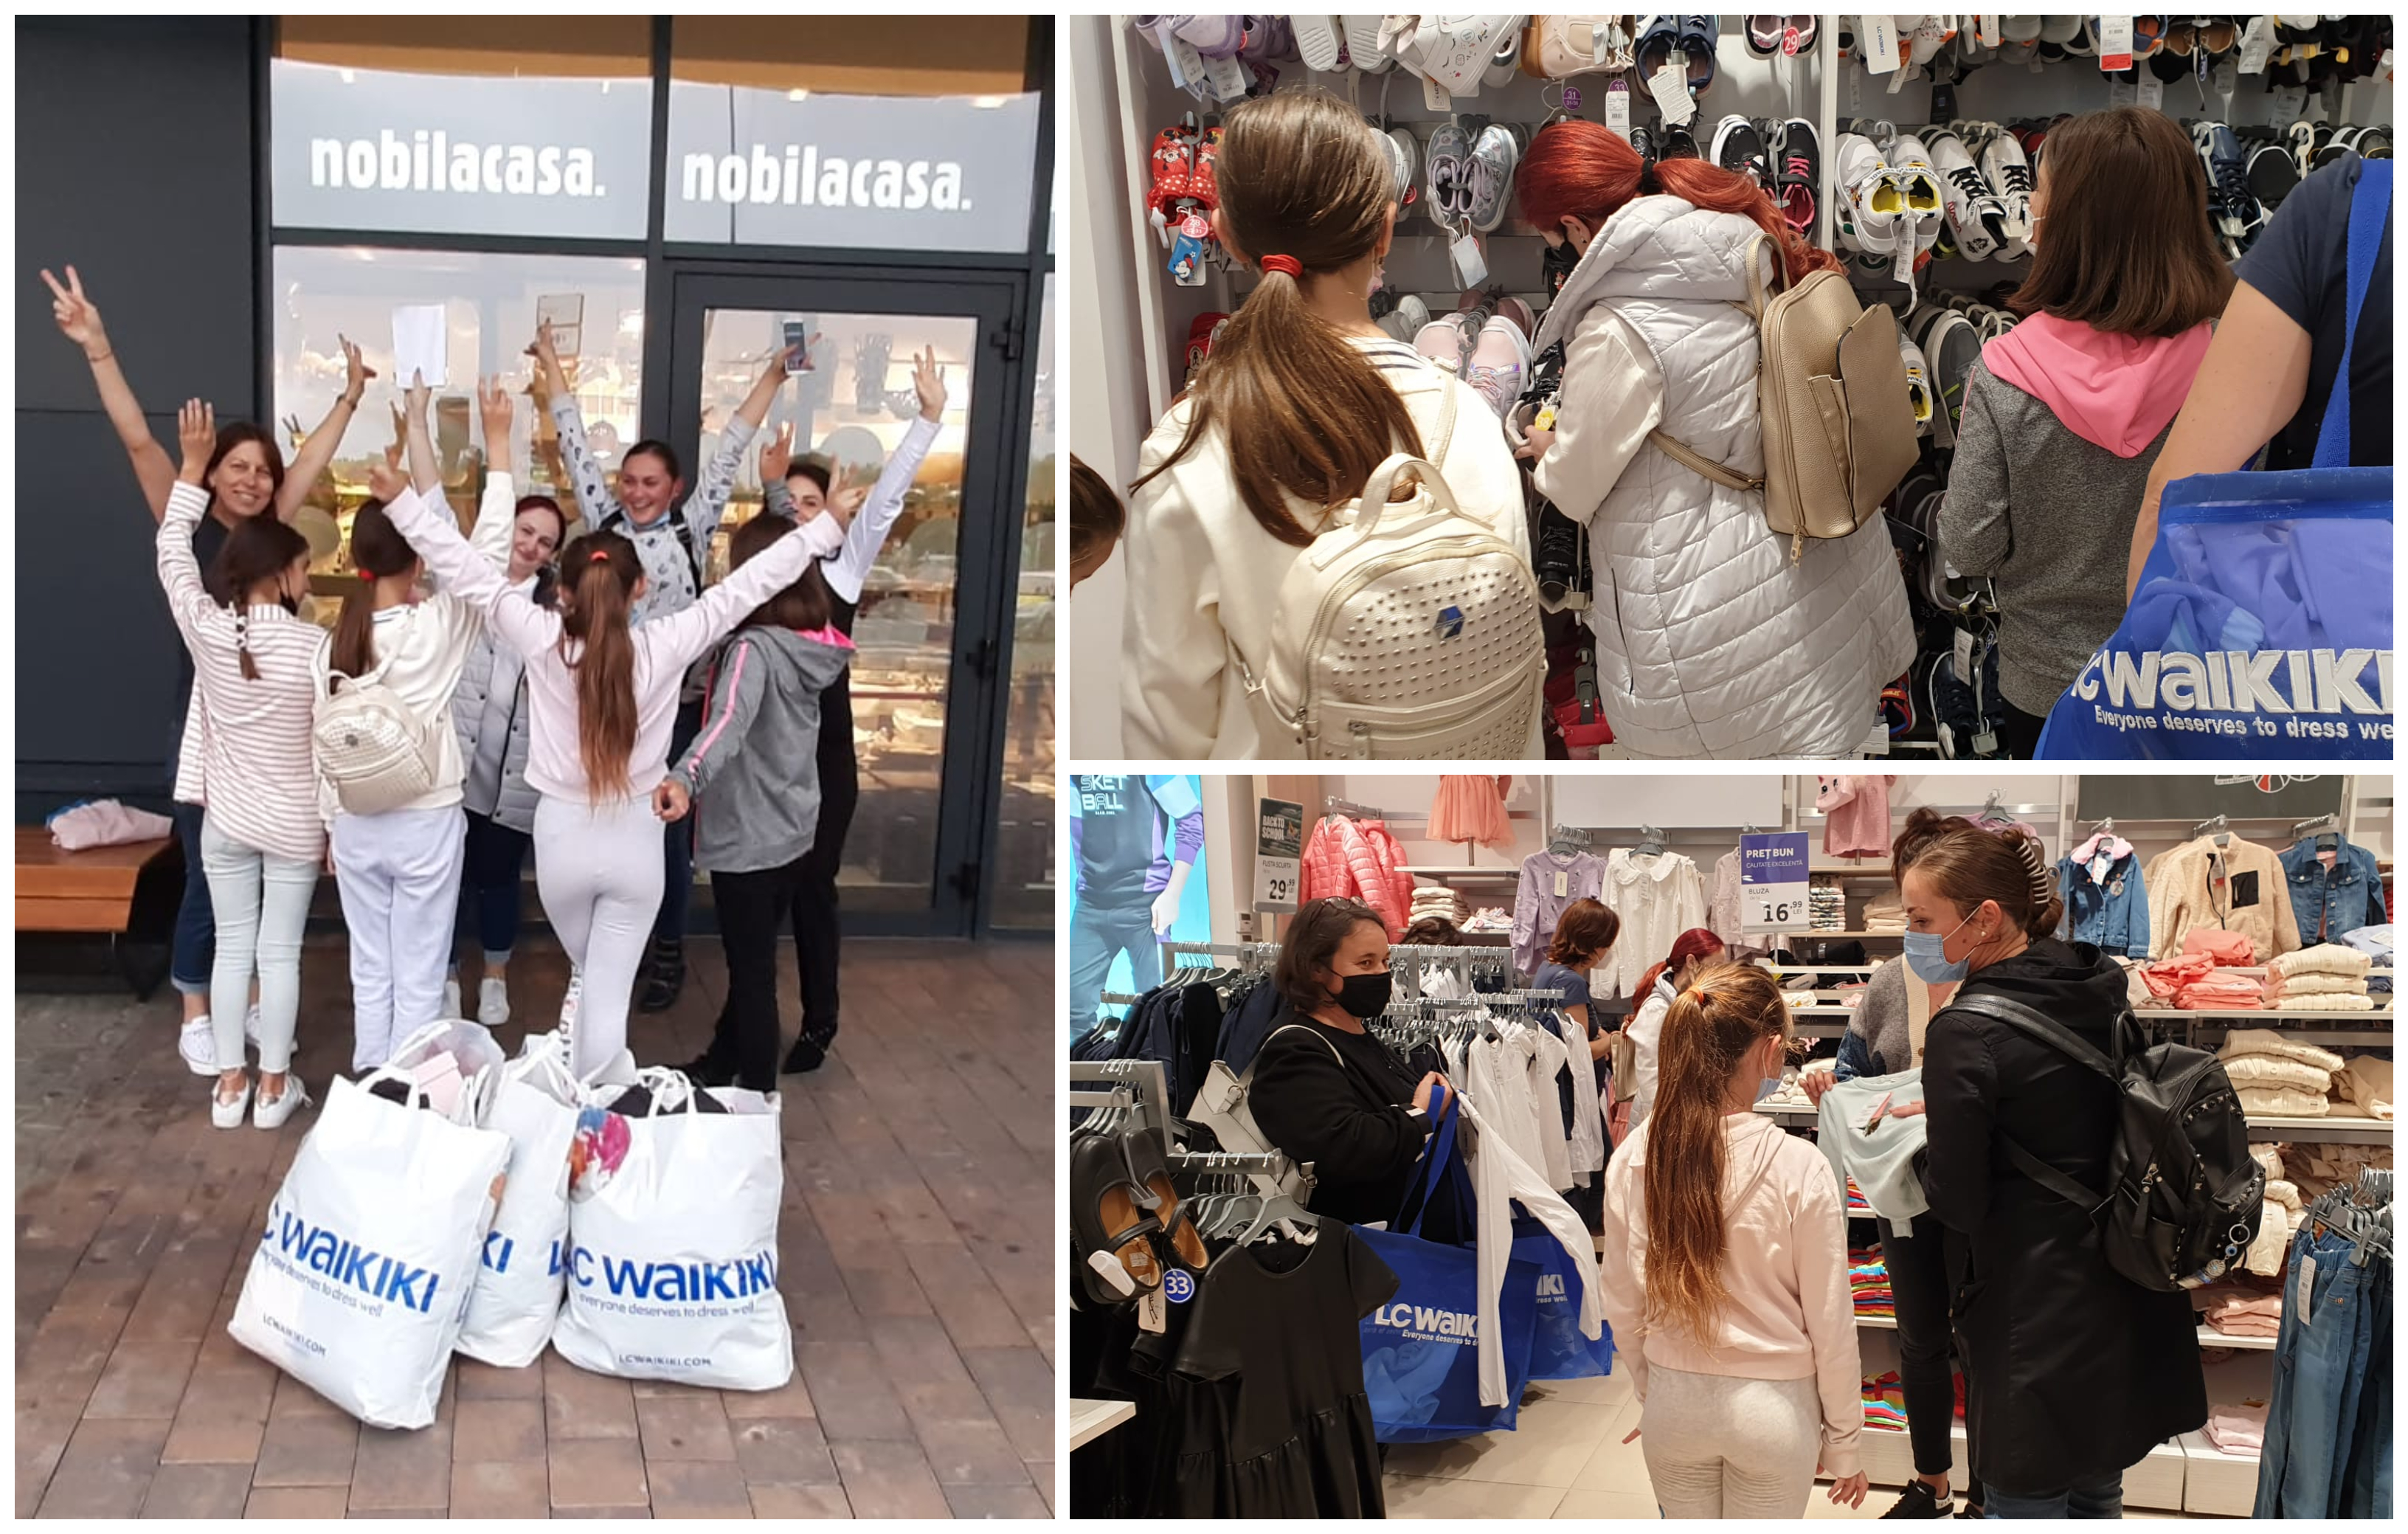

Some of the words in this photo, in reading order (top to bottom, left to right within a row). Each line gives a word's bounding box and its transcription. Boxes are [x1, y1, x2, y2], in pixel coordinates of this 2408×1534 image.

[1784, 33, 1799, 52] 29
[1568, 90, 1577, 98] 31
[311, 128, 606, 197] nobilacasa.
[682, 142, 972, 211] nobilacasa.
[2094, 704, 2158, 733] Everyone
[2162, 711, 2247, 736] deserves
[2256, 716, 2277, 737] to
[2286, 716, 2349, 739] dress
[1081, 775, 1128, 792] SKET
[1082, 792, 1124, 810] BALL
[1262, 815, 1278, 828] BACK
[1277, 818, 1285, 829] TO
[1262, 826, 1284, 840] SCHOOL
[1773, 847, 1794, 857] BUN
[1746, 860, 1771, 868] CALITATE
[1269, 879, 1287, 900] 29
[1762, 903, 1788, 922] 16
[1166, 1276, 1189, 1295] 33
[629, 1302, 681, 1317] deserves
[684, 1307, 696, 1317] to
[697, 1303, 729, 1317] dress
[1374, 1302, 1413, 1328] LC
[1402, 1329, 1434, 1341] Everyone
[1435, 1334, 1464, 1344] deserves
[618, 1353, 712, 1367] LCWAIKIKI.COM
